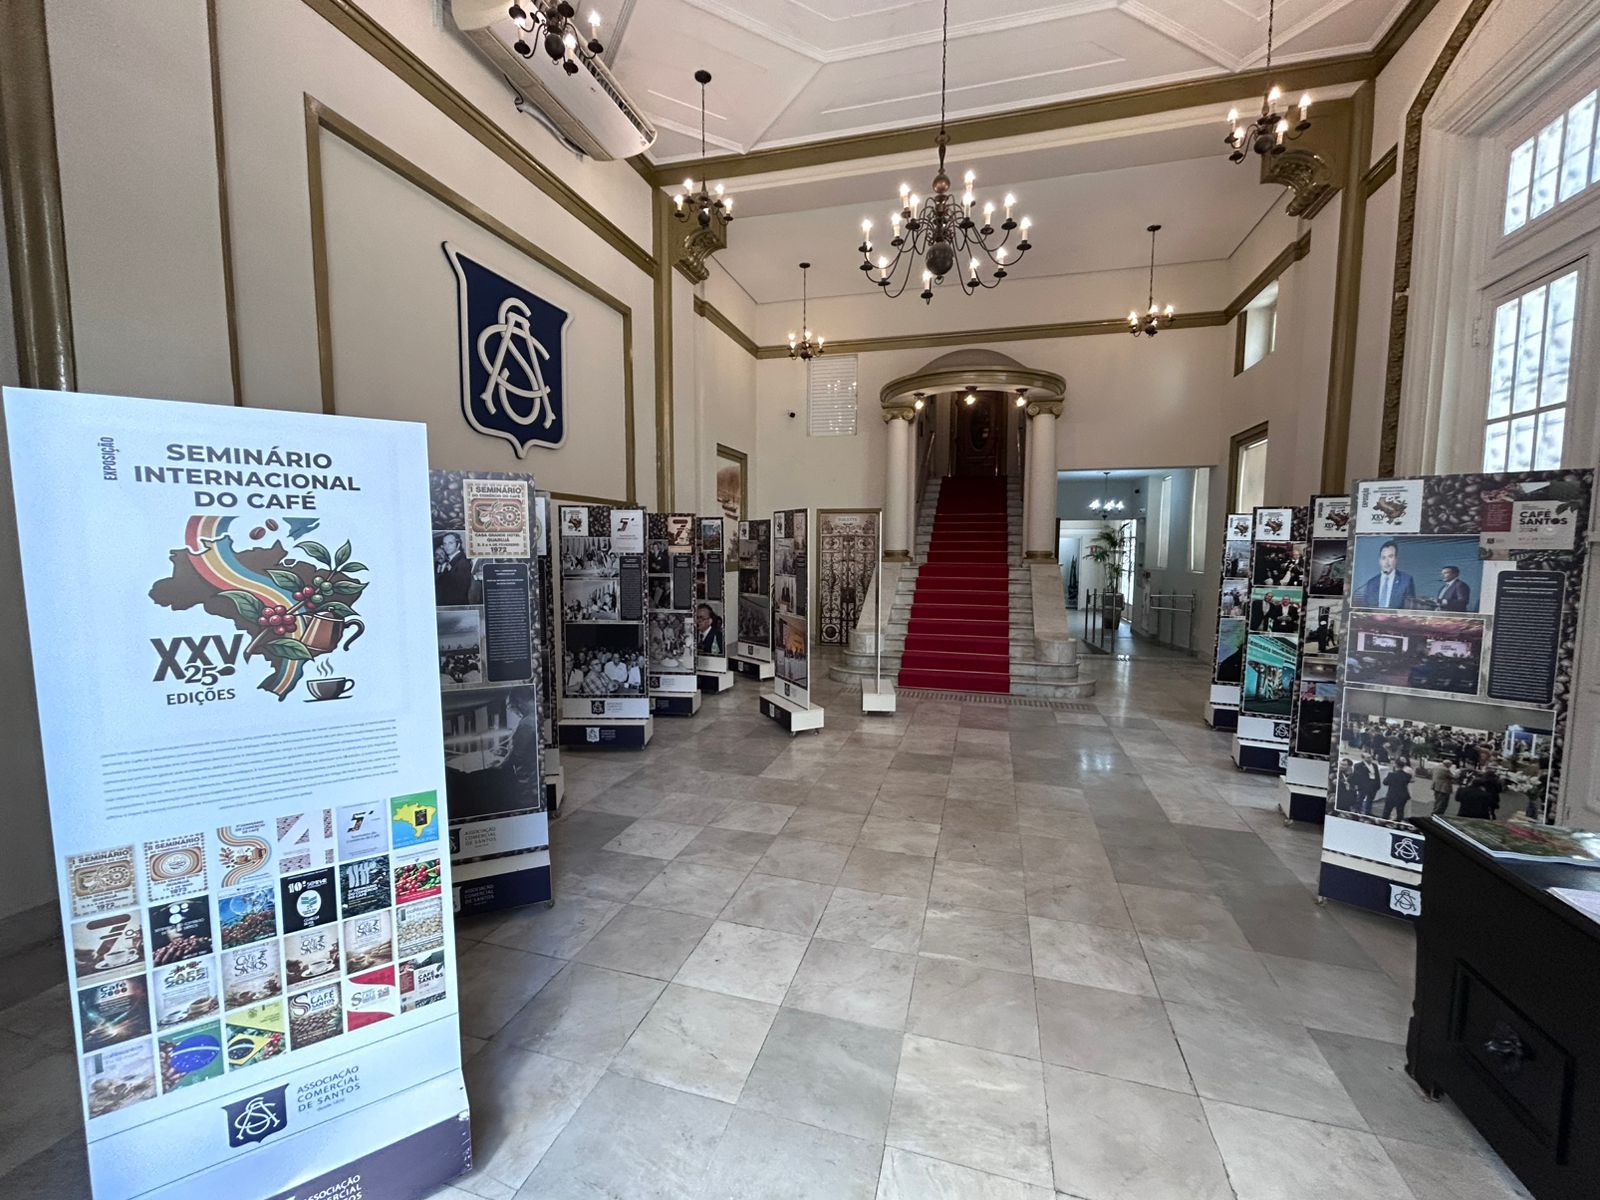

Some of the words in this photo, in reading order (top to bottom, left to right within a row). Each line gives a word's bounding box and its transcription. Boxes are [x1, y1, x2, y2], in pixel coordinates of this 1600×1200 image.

[98, 436, 120, 481] EXPOSIÇÃO
[166, 443, 332, 470] SEMINÁRIO
[134, 465, 361, 491] INTERNACIONAL
[193, 491, 238, 508] DO
[247, 490, 317, 511] CAFÉ
[1520, 509, 1551, 518] CAFÉ
[150, 632, 244, 682] XXV
[184, 664, 218, 686] 25
[166, 687, 236, 706] EDIÇÕES
[297, 1065, 359, 1094] ASSOCIAÇÃO
[297, 1075, 360, 1103] COMERCIAL
[298, 1101, 313, 1112] DE
[317, 1083, 360, 1105] SANTOS
[304, 1174, 361, 1200] SSOCIAÇÃO
